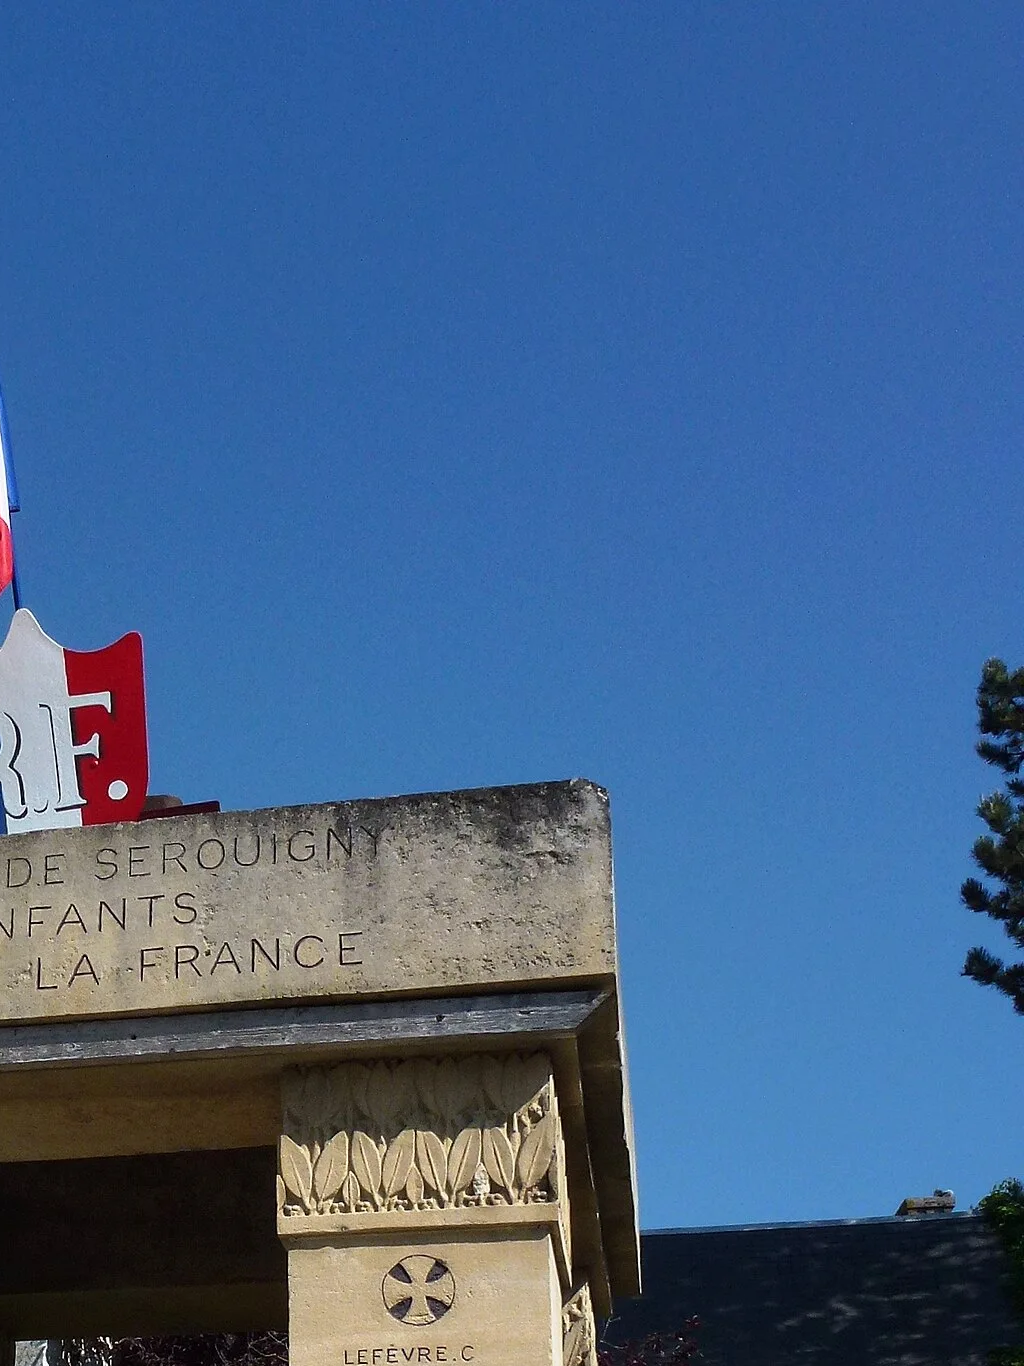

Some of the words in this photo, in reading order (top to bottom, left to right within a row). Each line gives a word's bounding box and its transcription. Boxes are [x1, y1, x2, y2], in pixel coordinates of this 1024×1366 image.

[6, 853, 66, 889] DE
[95, 823, 390, 881] SEROUIGNY
[36, 954, 100, 990] LA
[140, 931, 364, 982] FRANCE
